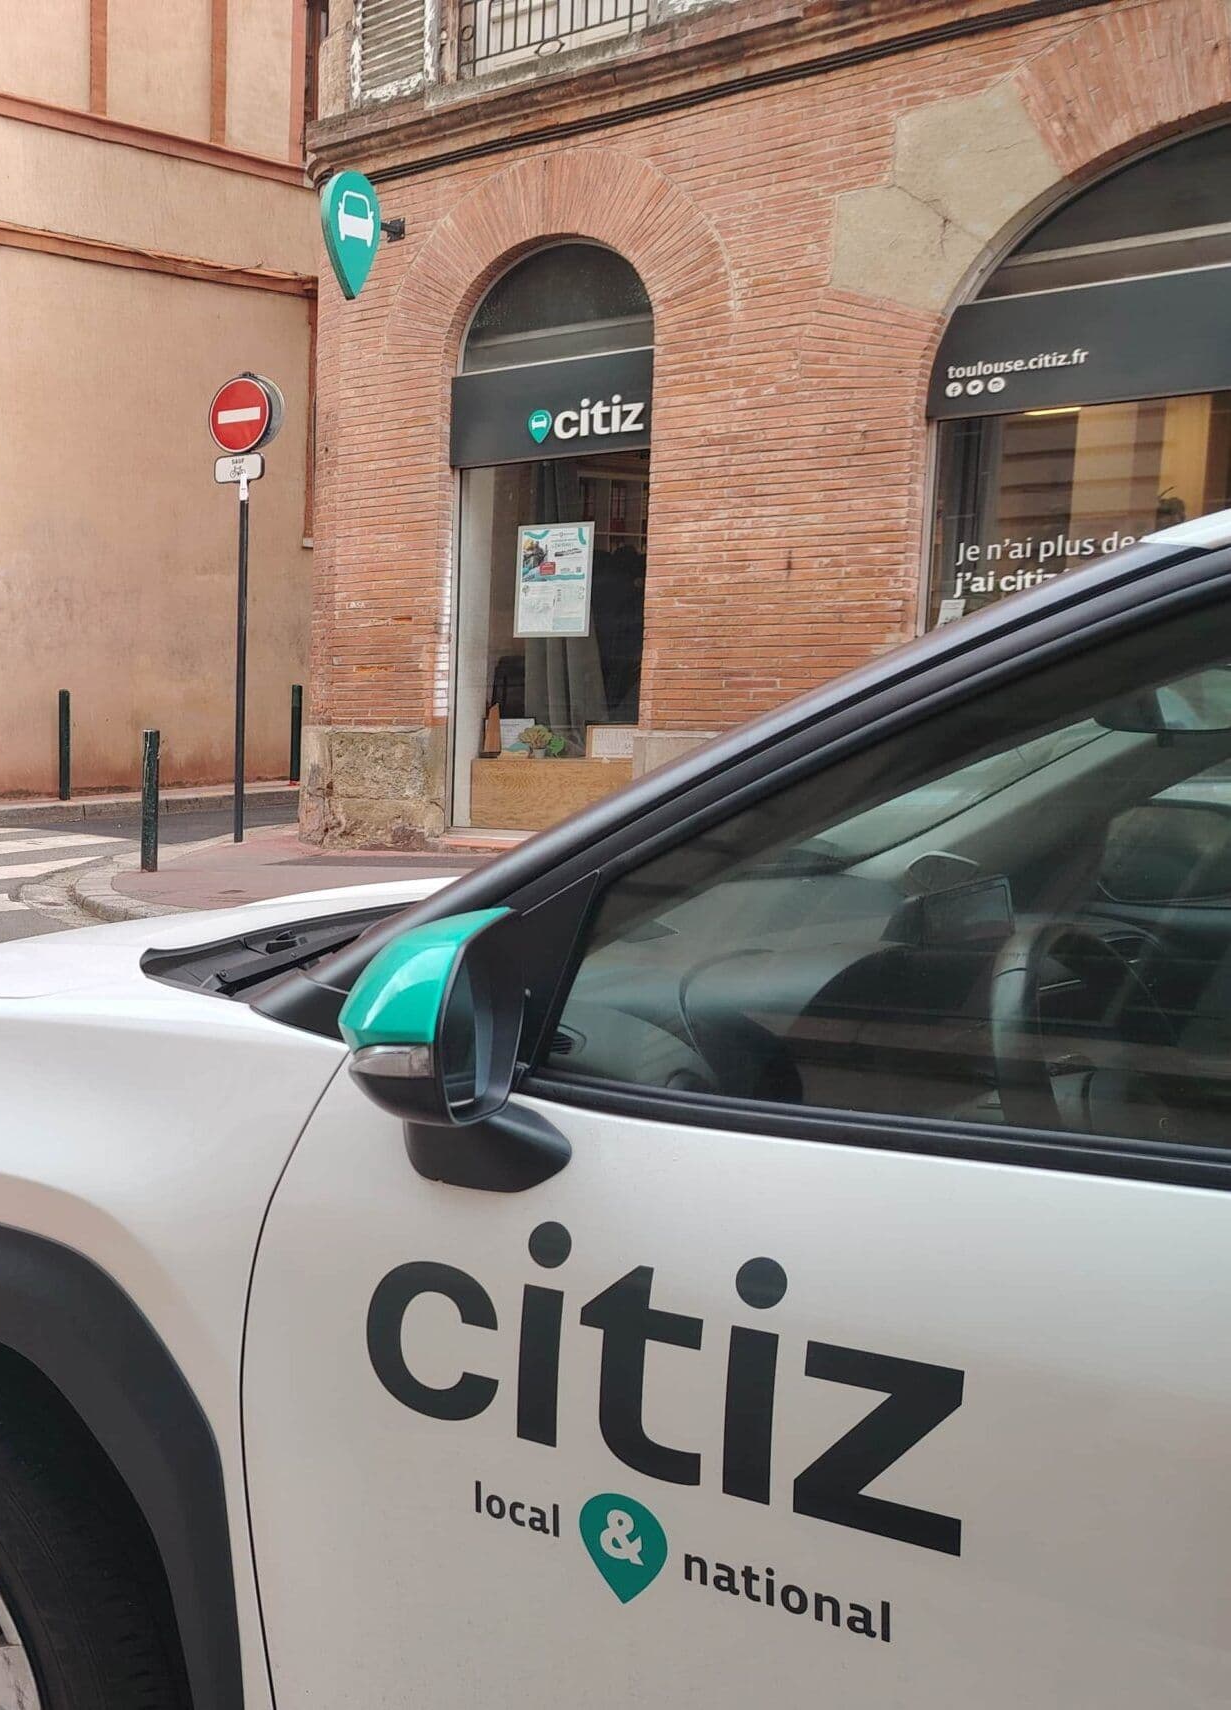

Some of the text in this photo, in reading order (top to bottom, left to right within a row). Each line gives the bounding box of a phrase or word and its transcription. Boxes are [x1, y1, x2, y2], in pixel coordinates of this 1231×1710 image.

[947, 348, 1090, 380] toulouse.citiz.fr
[553, 394, 645, 440] citiz
[956, 542, 980, 566] Je
[1039, 534, 1095, 562] plus
[999, 568, 1071, 591] citi
[366, 1220, 966, 1557] citiz
[474, 1480, 893, 1643] local & national
